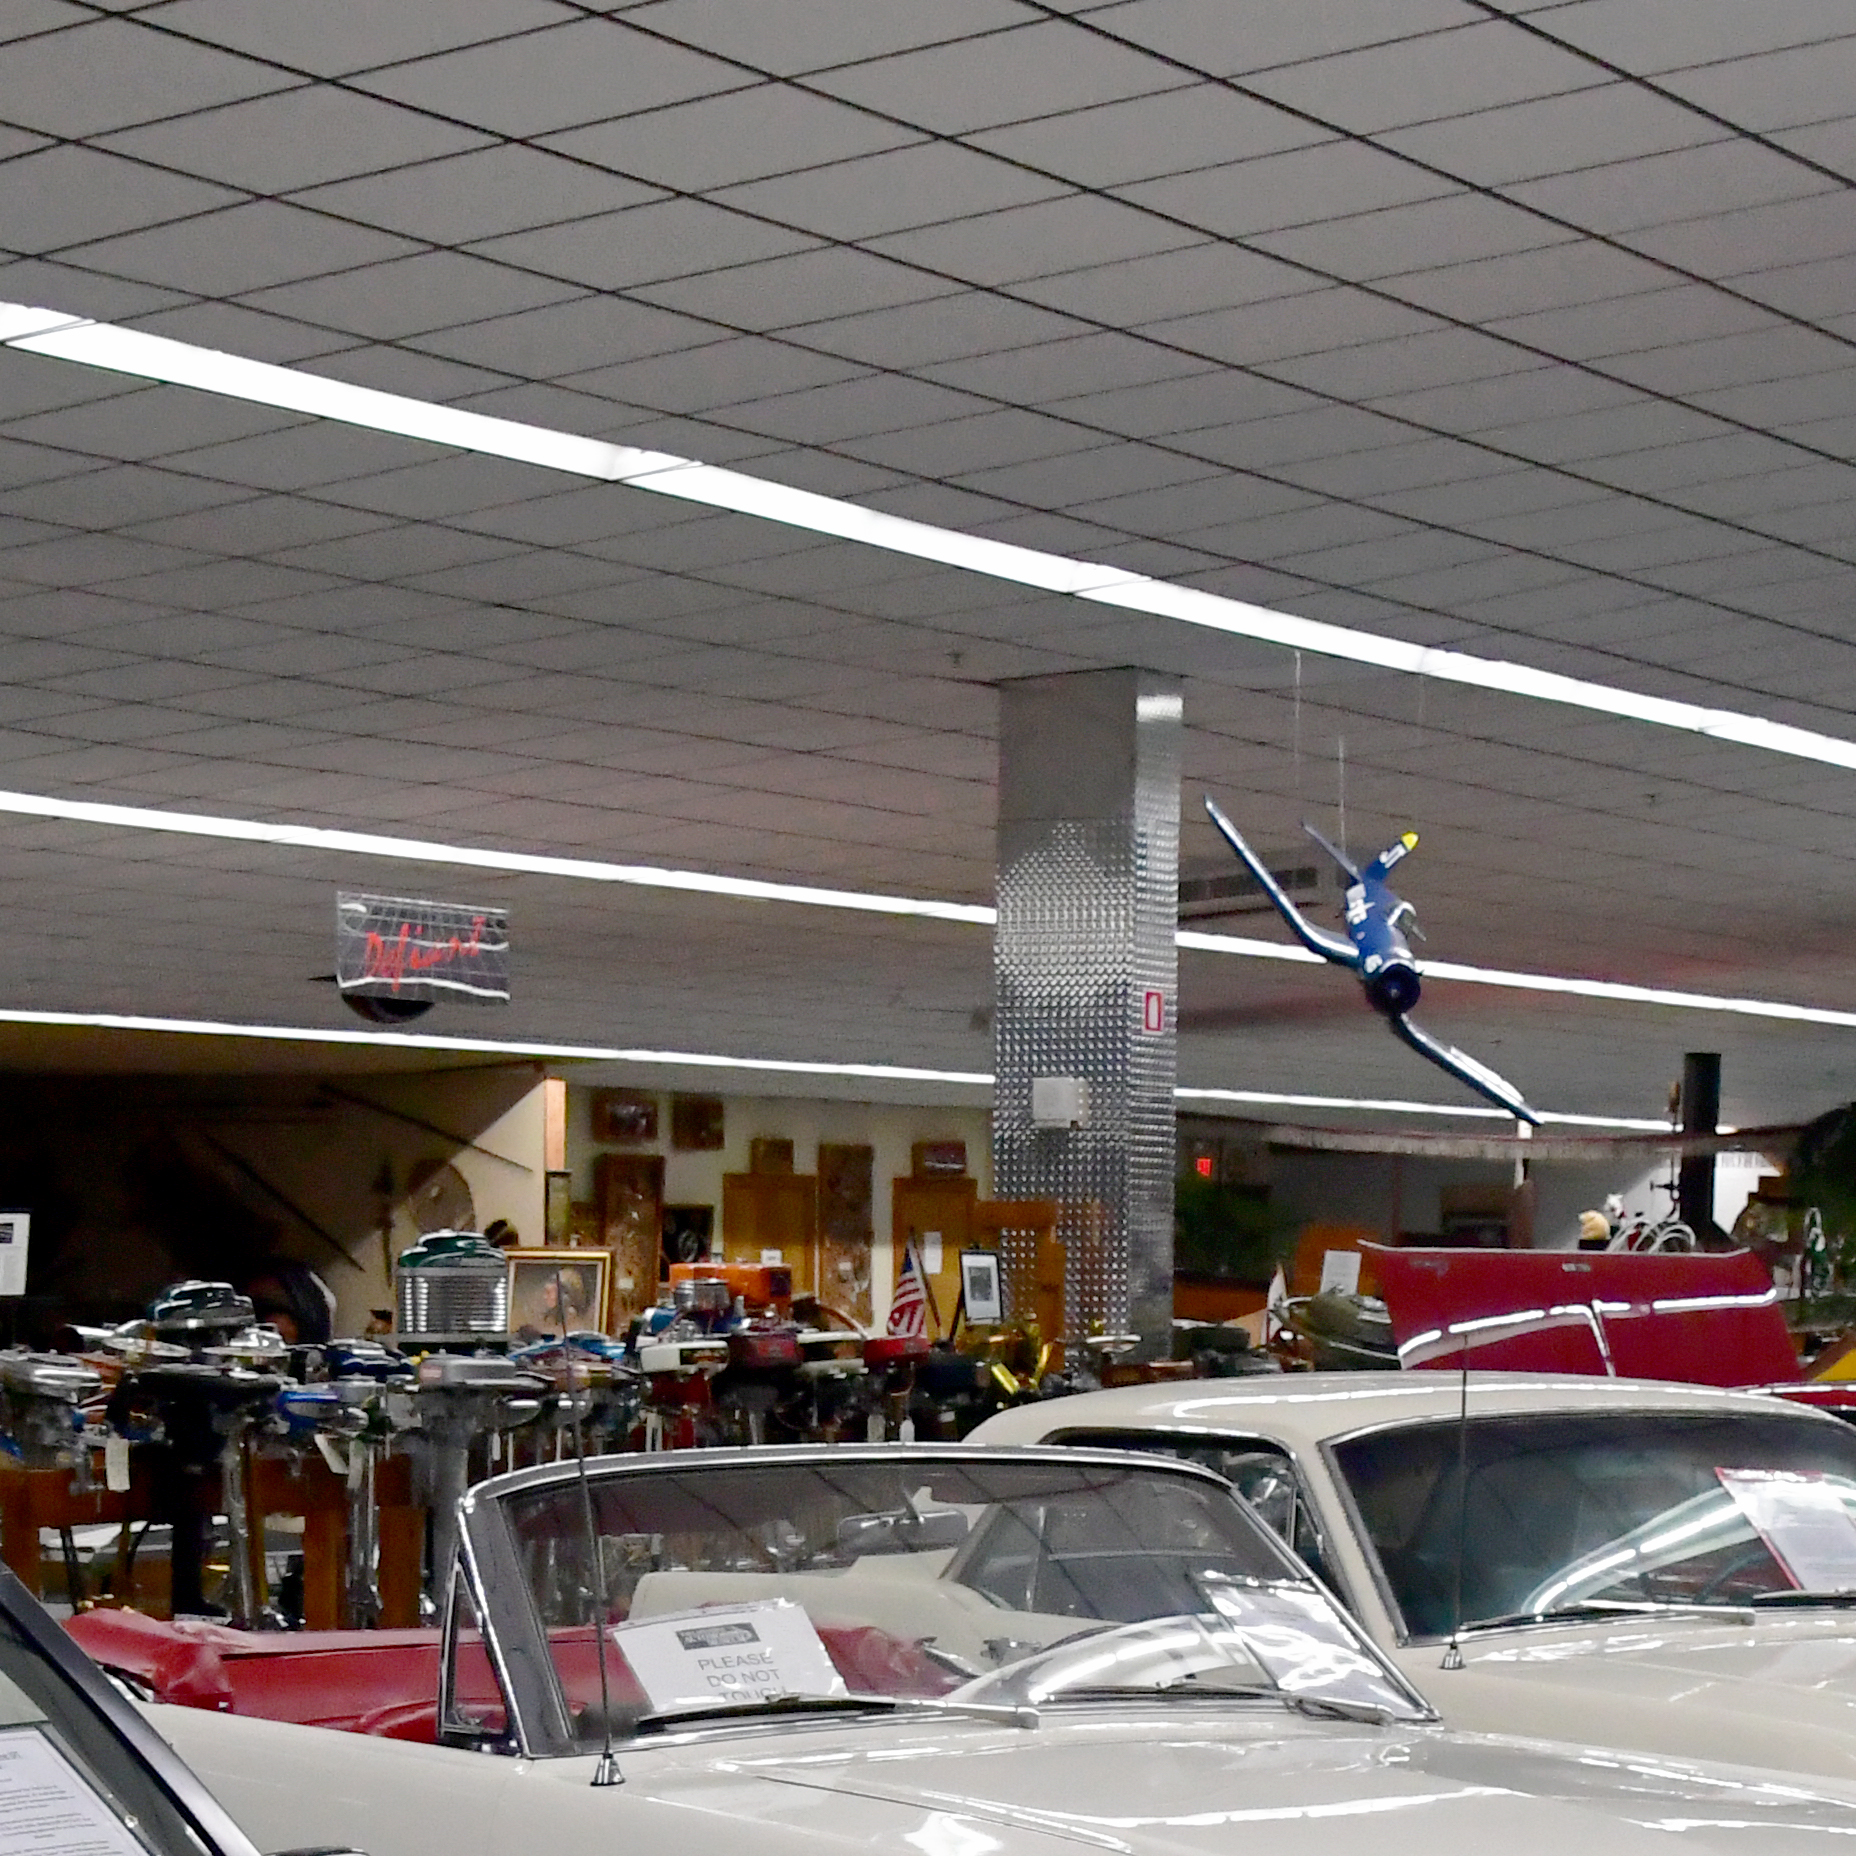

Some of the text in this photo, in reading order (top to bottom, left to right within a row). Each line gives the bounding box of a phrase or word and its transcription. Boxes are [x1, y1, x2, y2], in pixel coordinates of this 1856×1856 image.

[698, 1652, 774, 1671] PLEASE
[707, 1669, 780, 1687] DO NOT
